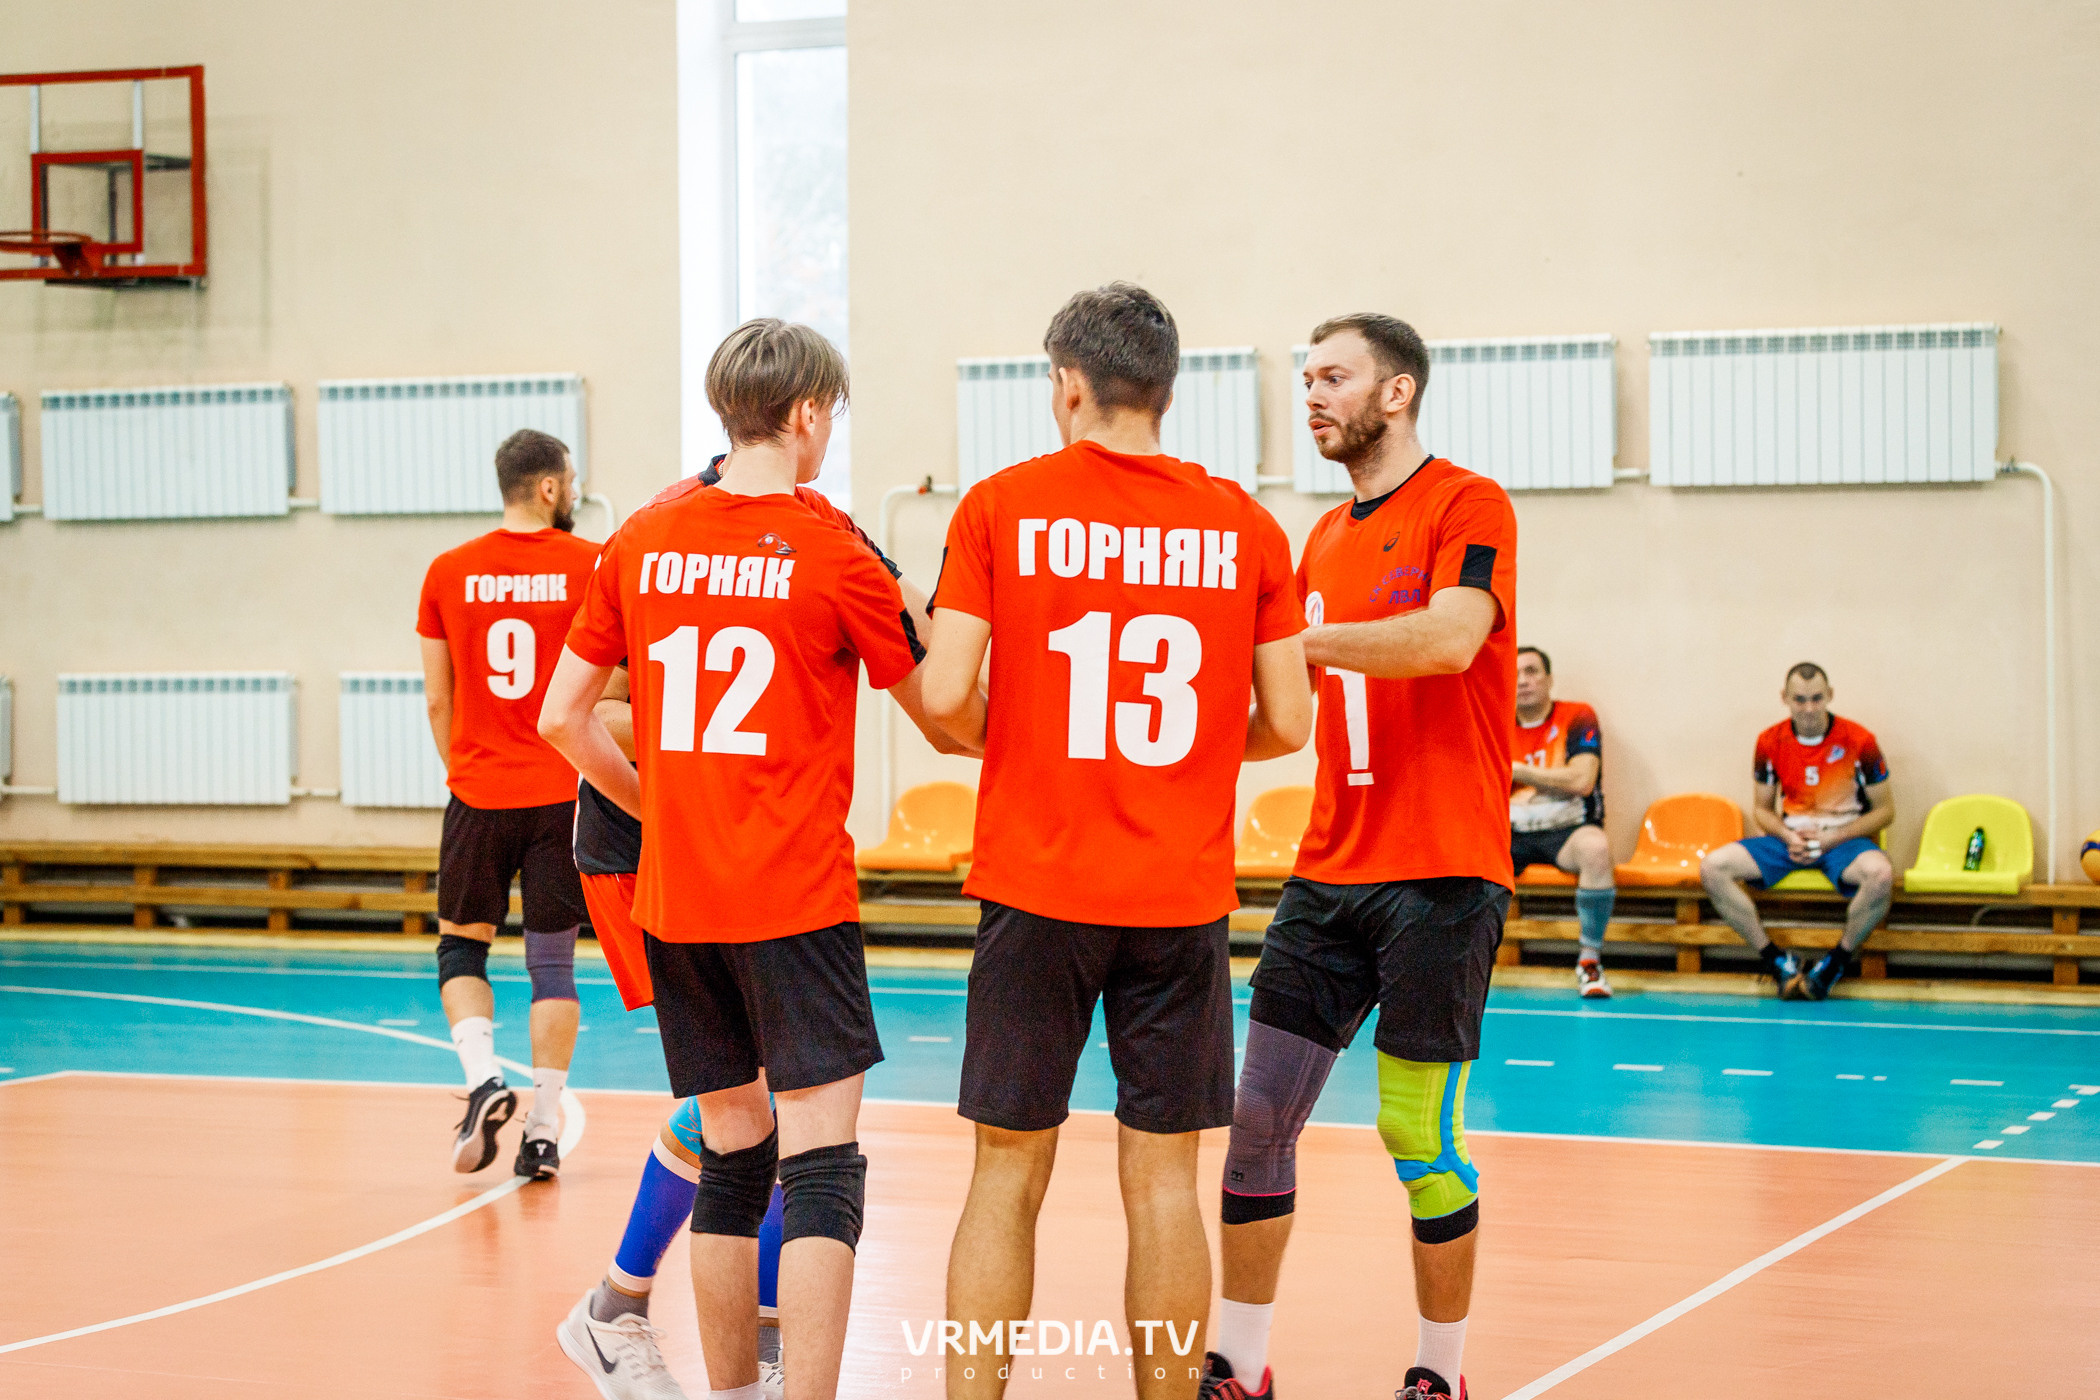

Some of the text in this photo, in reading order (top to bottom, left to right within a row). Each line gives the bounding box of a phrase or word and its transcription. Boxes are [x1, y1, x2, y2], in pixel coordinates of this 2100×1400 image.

[465, 574, 567, 603] ГОРНЯК
[639, 552, 796, 600] ГОРНЯК
[1018, 518, 1238, 590] ГОРНЯК
[487, 618, 536, 700] 9
[648, 626, 776, 756] 12
[1048, 611, 1202, 767] 13
[1805, 765, 1819, 786] 5
